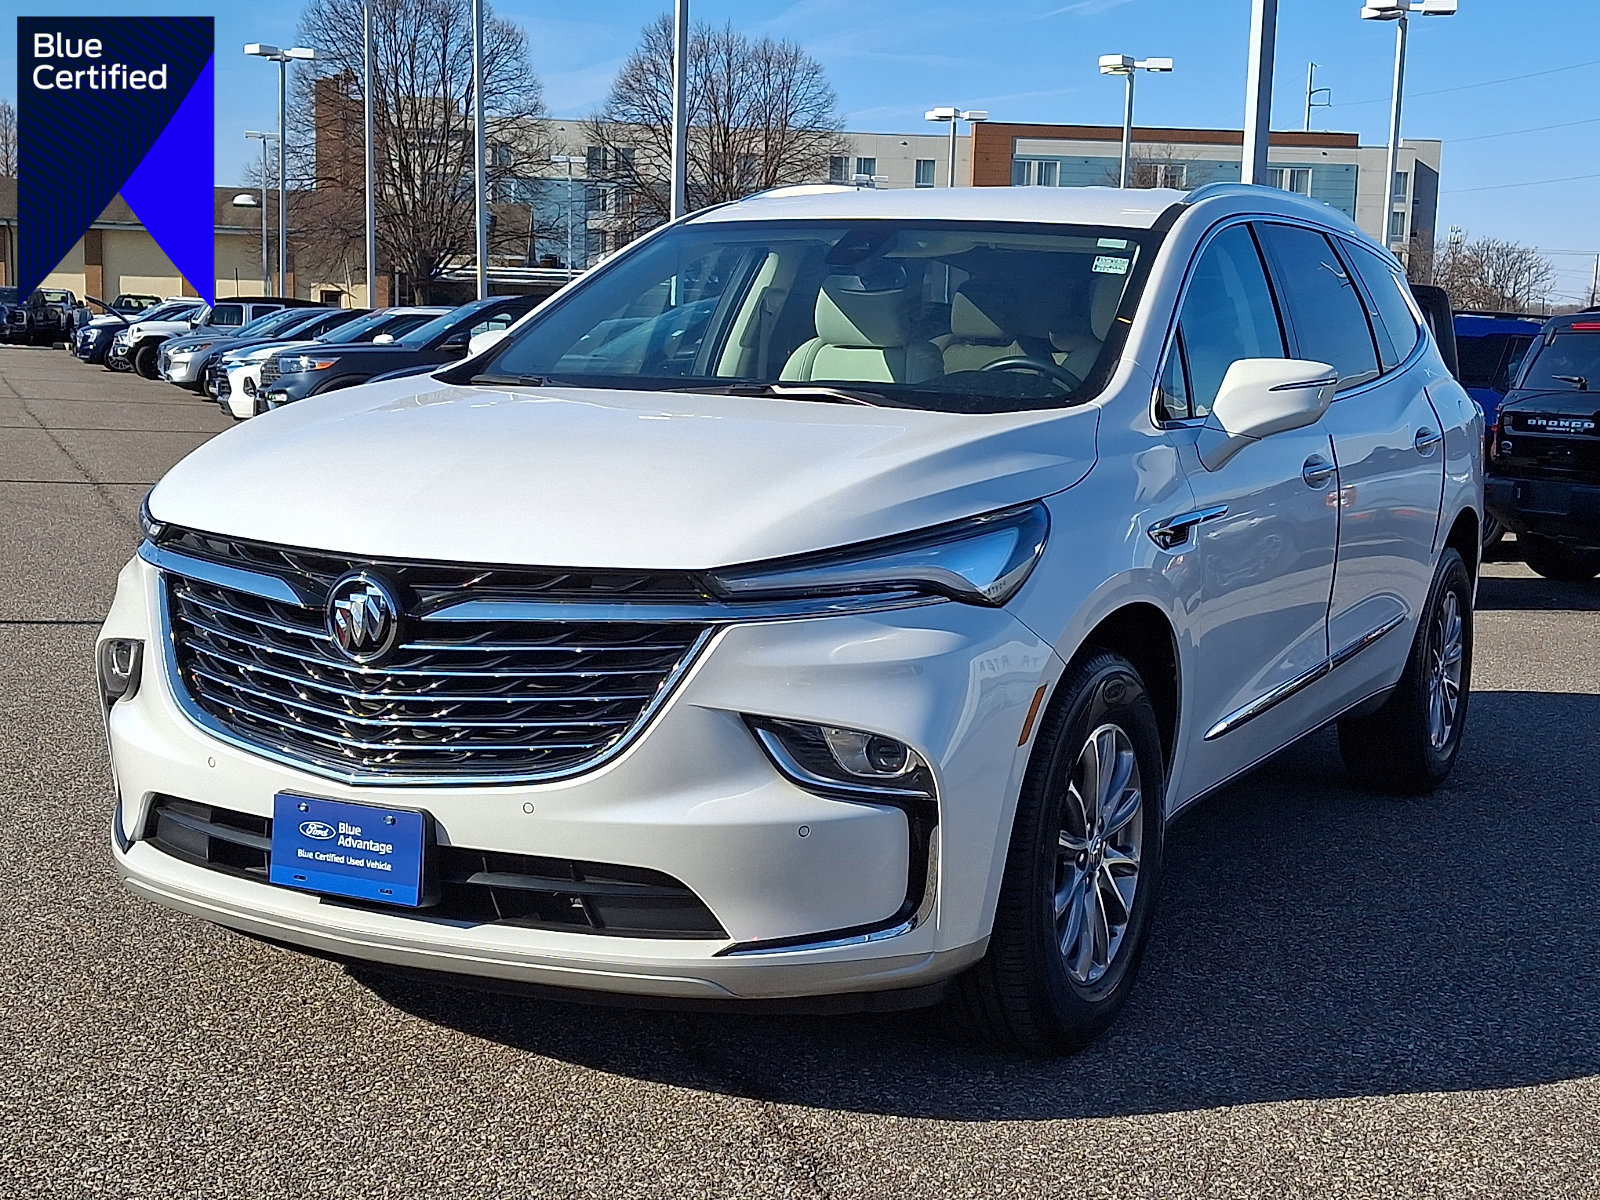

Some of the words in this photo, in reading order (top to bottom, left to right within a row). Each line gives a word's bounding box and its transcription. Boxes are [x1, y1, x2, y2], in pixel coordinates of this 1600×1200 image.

[306, 823, 329, 836] Ford
[338, 822, 362, 836] Blue
[338, 835, 393, 855] Advantage
[298, 849, 314, 860] Blue
[315, 851, 345, 864] Certified
[346, 857, 365, 867] Used
[366, 859, 392, 872] Vehicle
